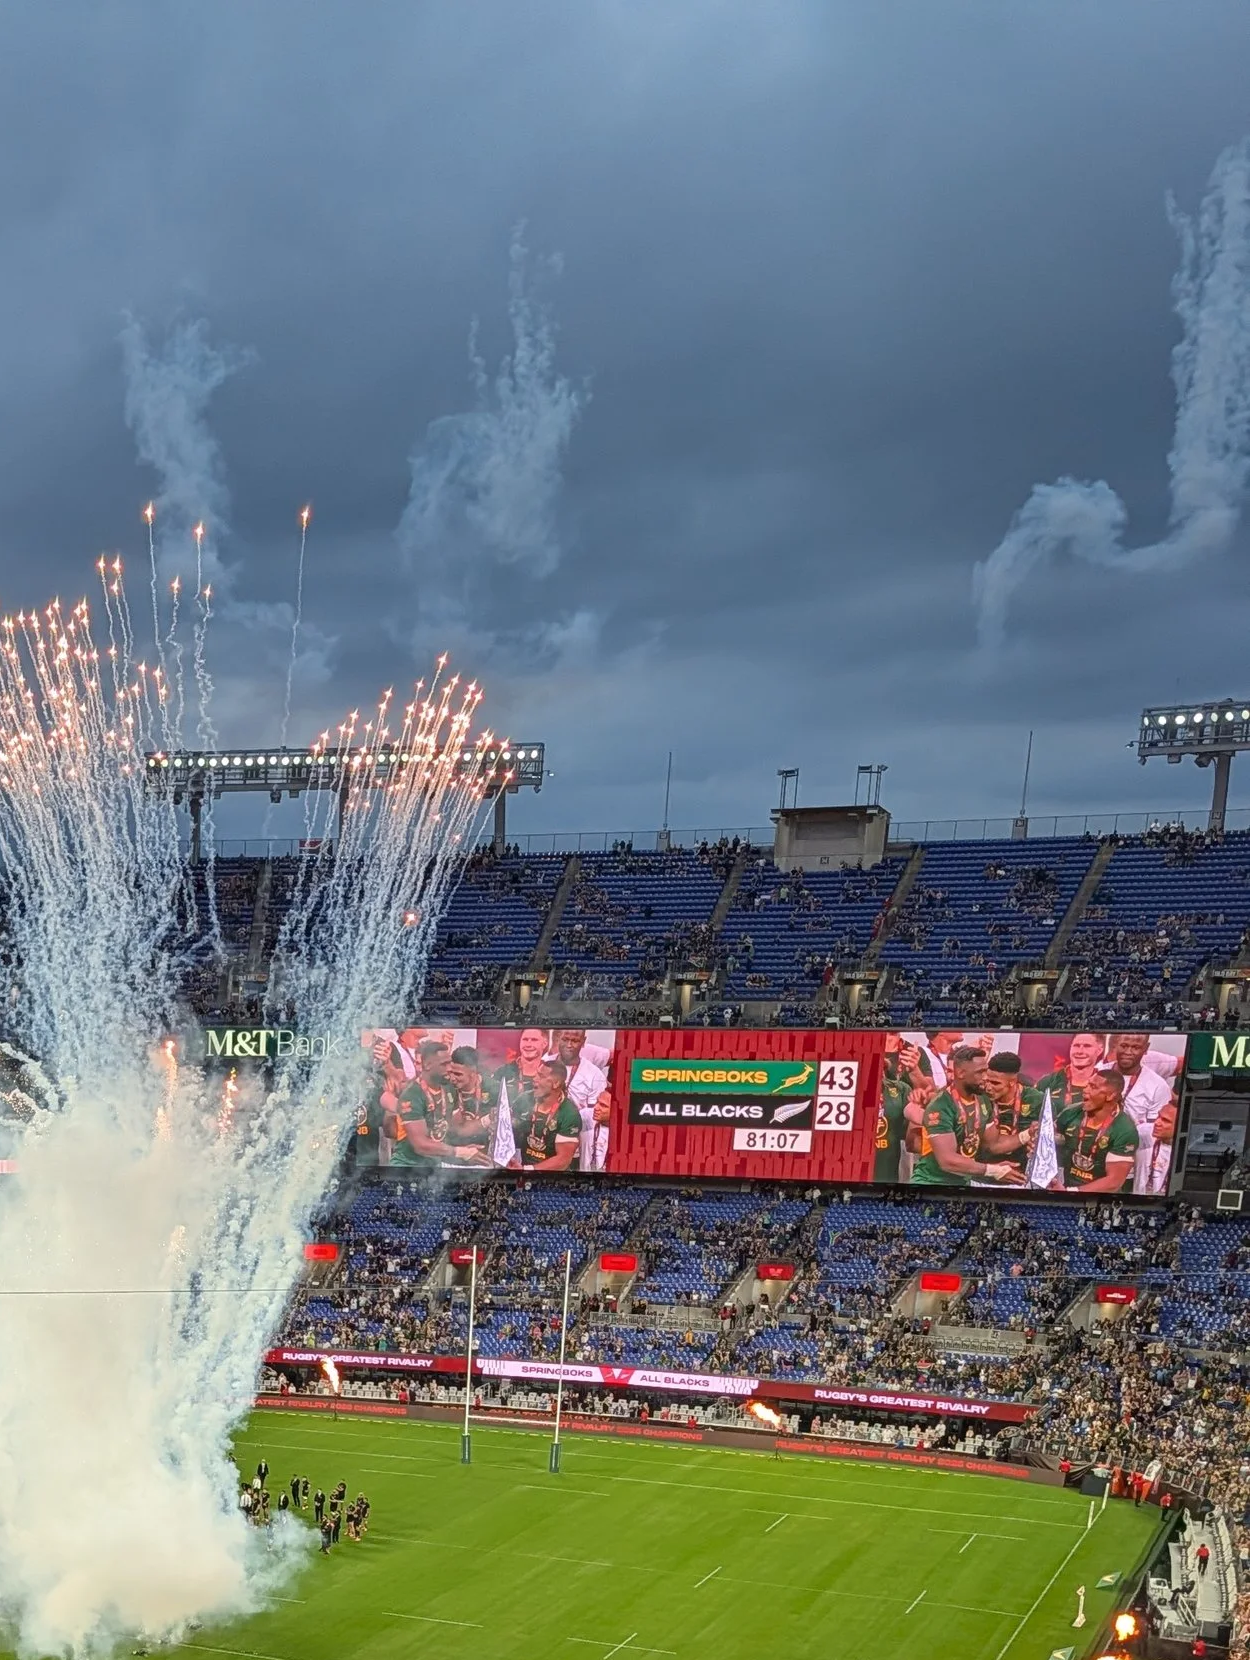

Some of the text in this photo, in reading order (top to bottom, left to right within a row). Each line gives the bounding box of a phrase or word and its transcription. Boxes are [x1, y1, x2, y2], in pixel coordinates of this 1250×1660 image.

[206, 1029, 342, 1057] M&T Bank
[1209, 1035, 1250, 1068] M
[641, 1066, 855, 1091] SPRINGBOKS 43
[639, 1101, 851, 1126] ALL BLACKS 28
[745, 1131, 800, 1150] 81:07
[874, 1138, 888, 1149] NB
[282, 1352, 433, 1367] RUGBY'S GREATEST RIVALRY
[521, 1365, 710, 1387] SPRINGBOKS ALL BLACKS
[288, 1400, 328, 1409] RIVALRY
[353, 1404, 407, 1415] CHAMPIONS
[814, 1389, 990, 1415] RUGBY'S GREATEST RIVALRY
[571, 1422, 615, 1433] RIVALRY
[642, 1429, 703, 1441] CHAMPIONS
[775, 1440, 825, 1452] RUGBY'S
[826, 1445, 885, 1459] GREATEST
[887, 1451, 936, 1464] RIVALRY
[965, 1461, 1030, 1477] CHAMPIONS
